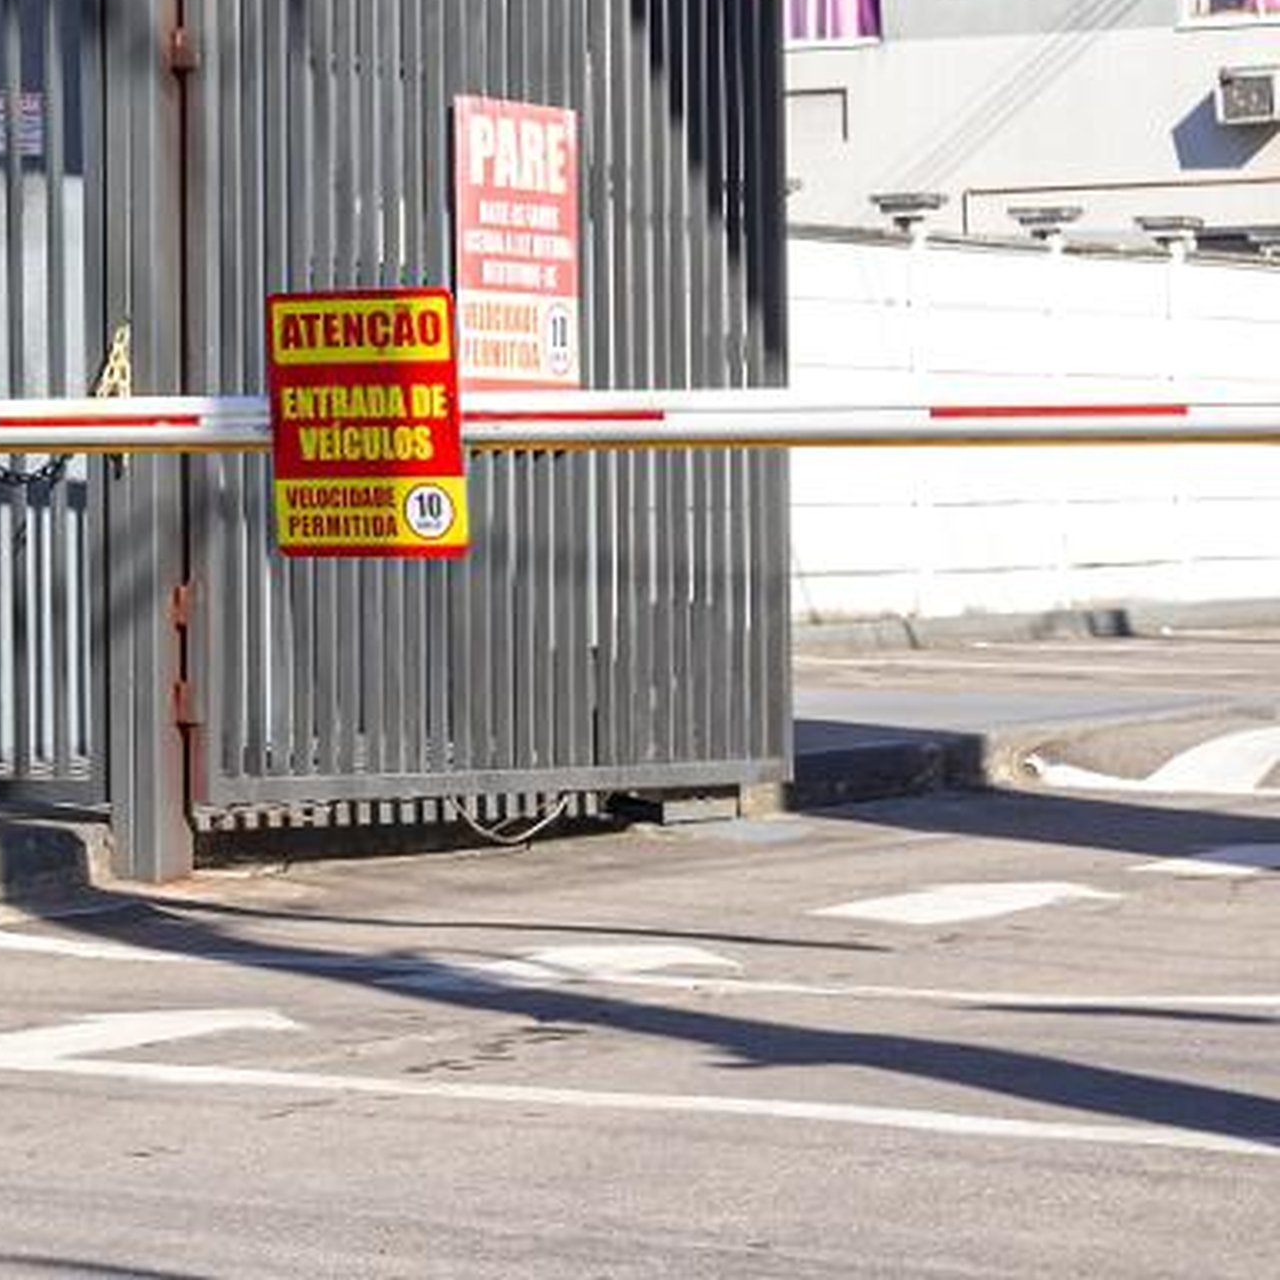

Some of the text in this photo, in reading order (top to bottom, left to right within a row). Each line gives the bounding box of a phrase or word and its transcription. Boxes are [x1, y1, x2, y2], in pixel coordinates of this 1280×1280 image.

[469, 116, 568, 195] PARE
[281, 303, 442, 355] ATENÇÃO
[282, 383, 448, 419] ENTRADA DE
[299, 421, 433, 461] VEÍCULOS
[286, 485, 397, 509] VELOCIDADE
[415, 492, 442, 519] 10
[289, 514, 398, 537] PERMITIDA
